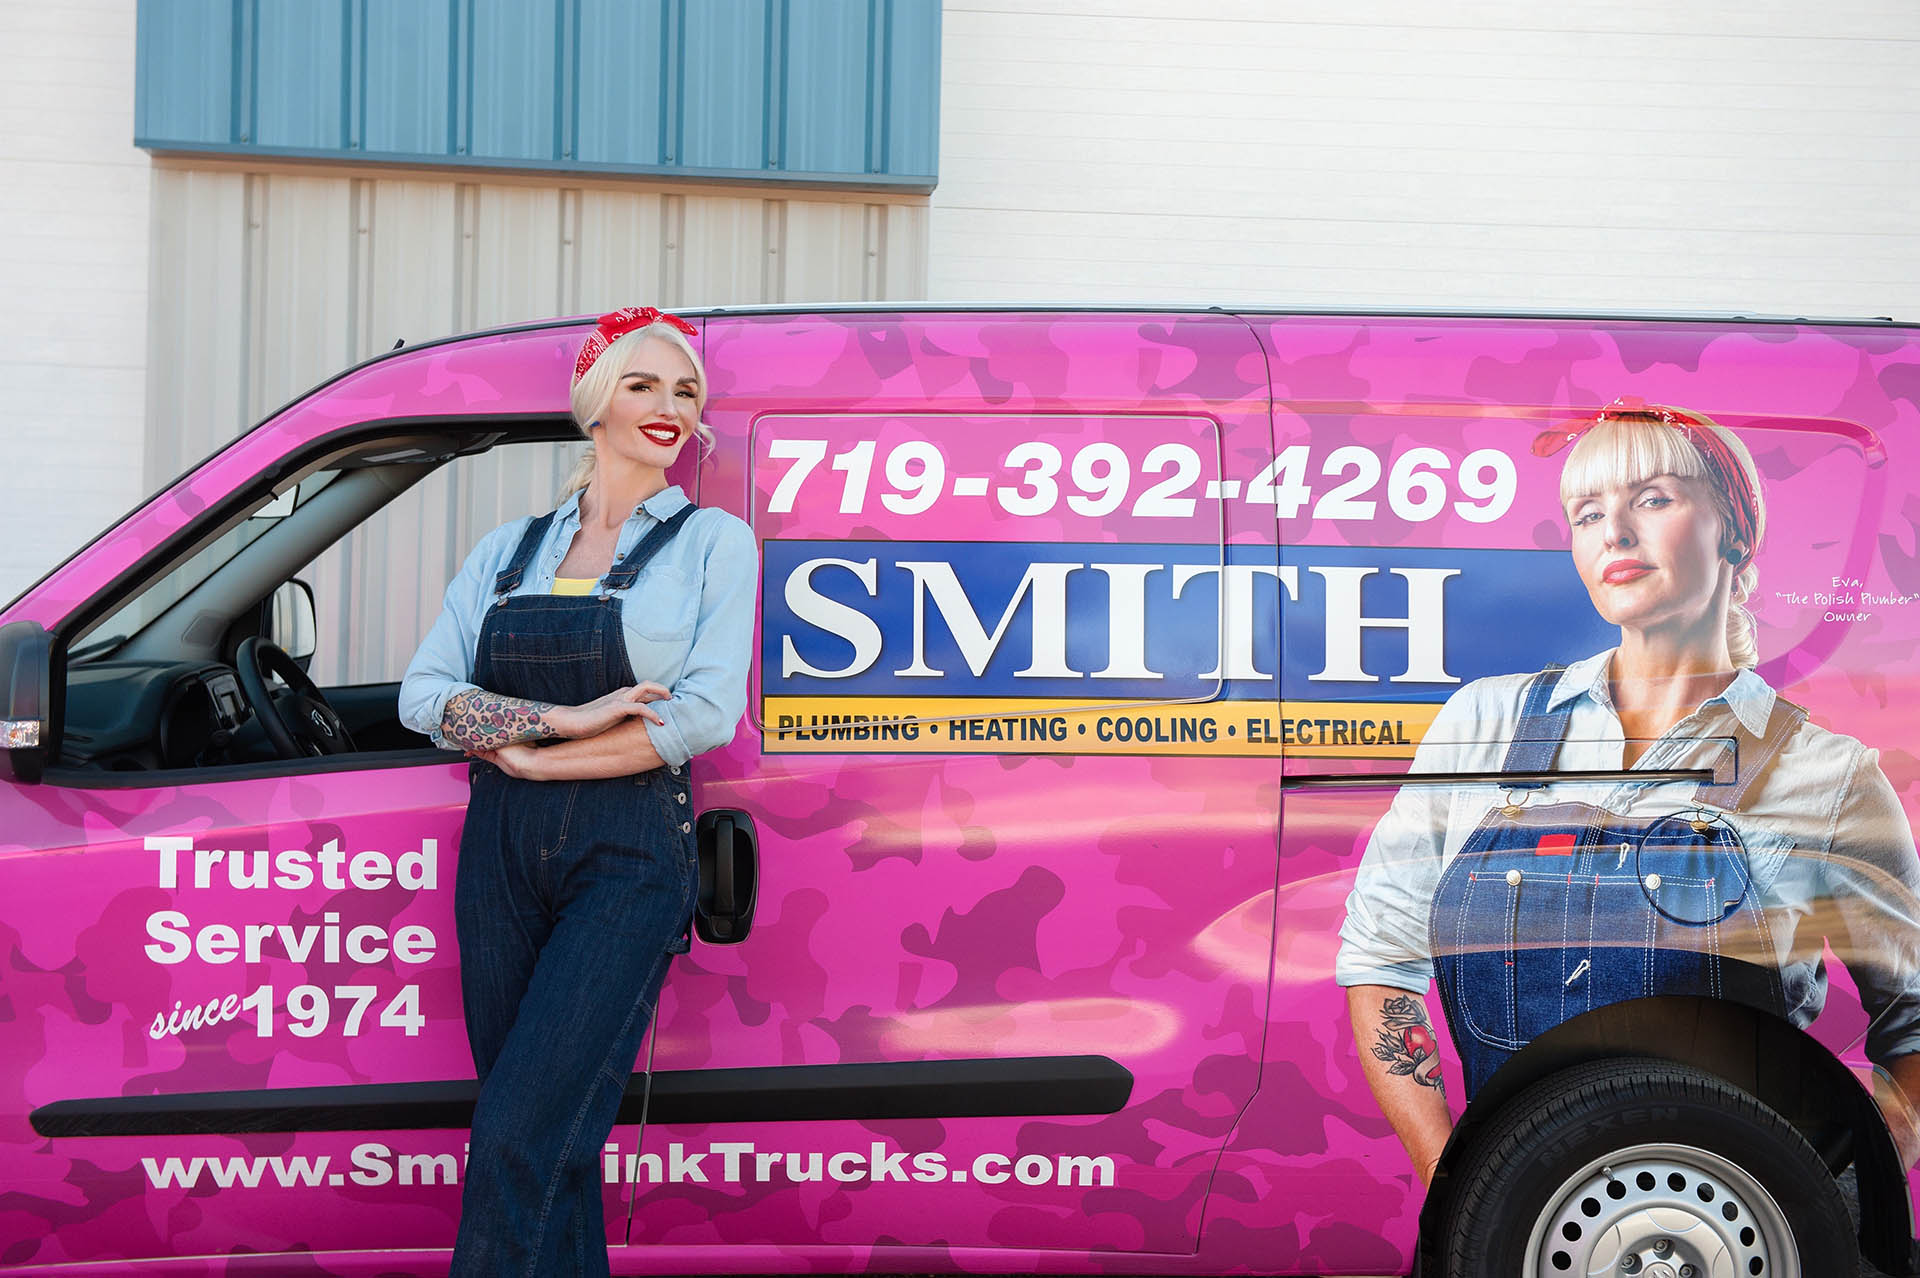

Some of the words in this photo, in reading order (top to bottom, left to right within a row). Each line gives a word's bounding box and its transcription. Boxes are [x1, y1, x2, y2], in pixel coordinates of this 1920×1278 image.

[767, 440, 1518, 523] 719-392-4269
[1775, 591, 1809, 605] "The
[1813, 592, 1855, 606] Polish
[1860, 592, 1920, 606] Plumber"
[1831, 576, 1864, 588] Eva,
[782, 557, 1463, 684] SMITH
[1823, 611, 1872, 622] Owner
[778, 714, 920, 741] PLUMBING
[949, 717, 1067, 742] HEATING
[1096, 716, 1217, 742] COOLING
[1247, 717, 1411, 745] ELECTRICAL
[143, 836, 438, 890] Trusted
[144, 911, 437, 964] Service
[149, 993, 243, 1040] since
[242, 985, 426, 1037] 1974
[1536, 1105, 1680, 1169] NEXEN
